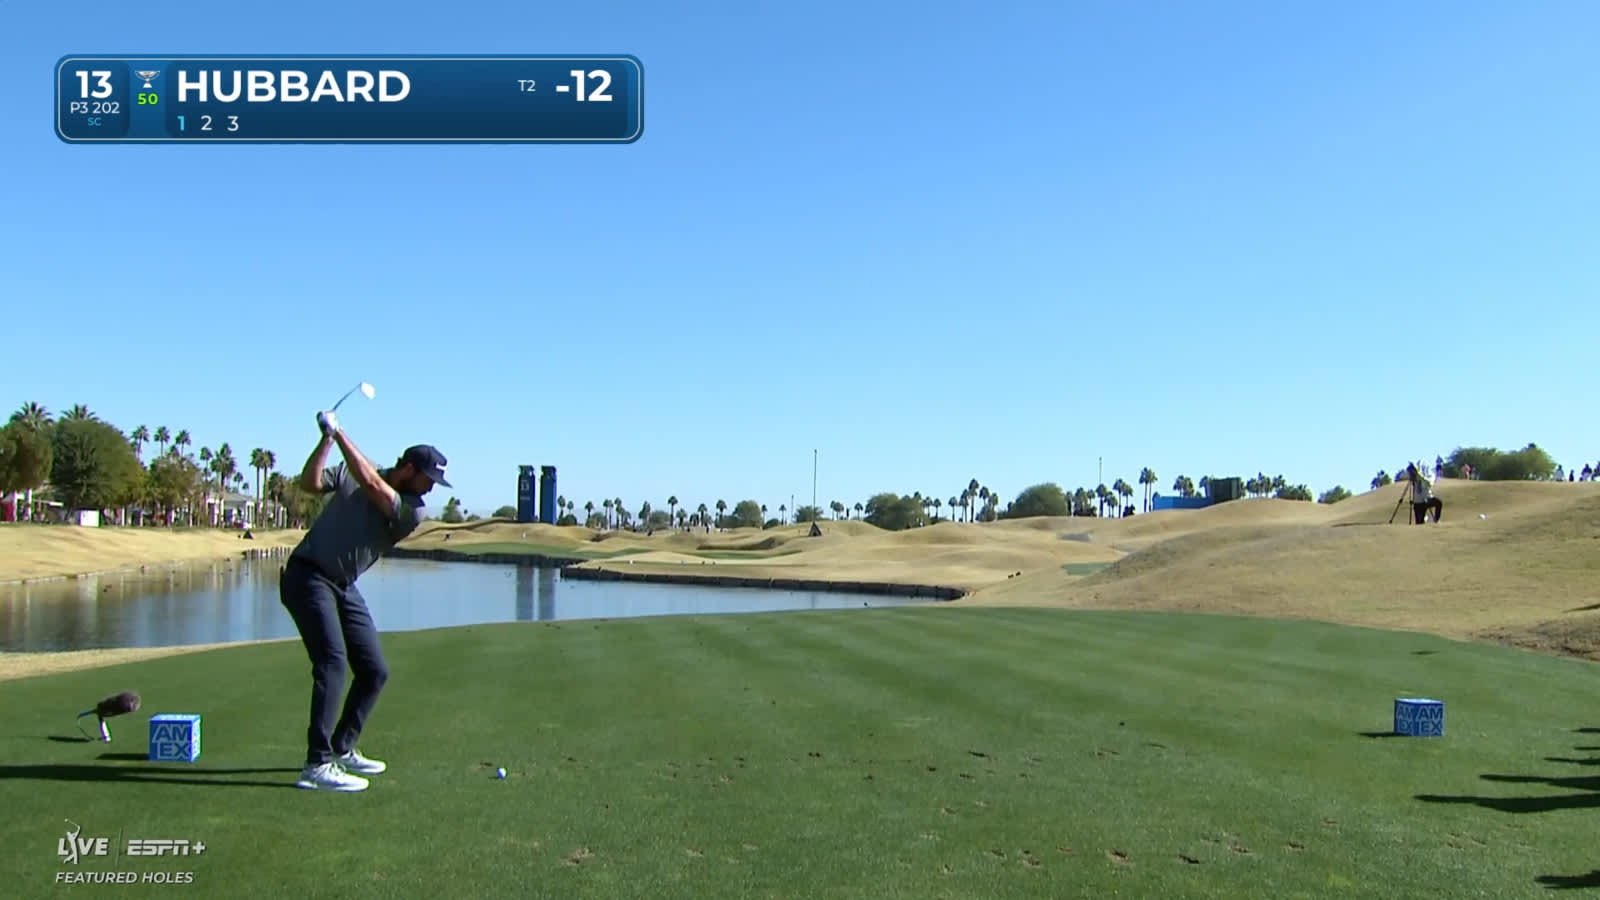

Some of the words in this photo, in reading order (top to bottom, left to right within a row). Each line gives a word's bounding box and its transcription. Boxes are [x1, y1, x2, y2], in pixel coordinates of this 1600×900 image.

[1415, 704, 1441, 720] AM
[151, 724, 189, 743] AM
[1419, 719, 1442, 736] EX
[157, 742, 190, 760] EX
